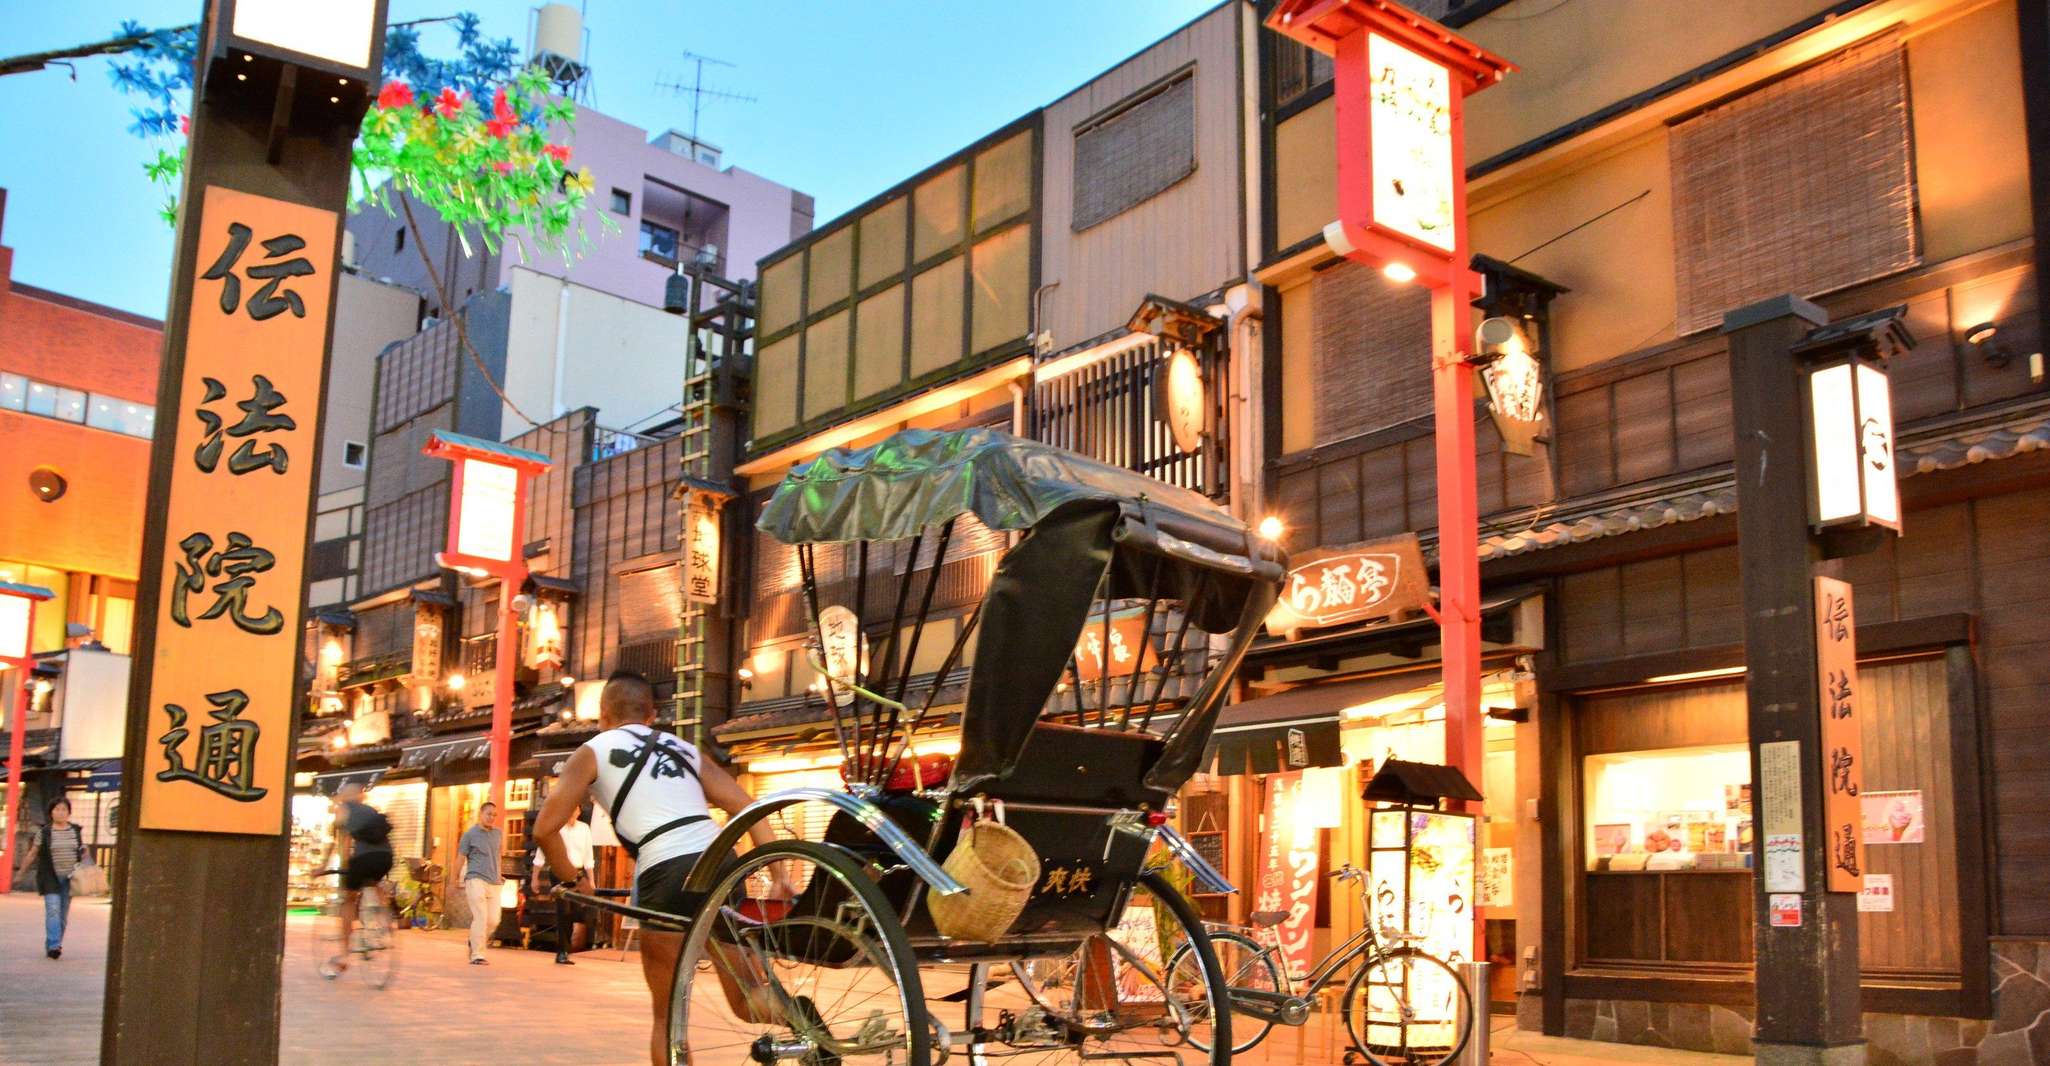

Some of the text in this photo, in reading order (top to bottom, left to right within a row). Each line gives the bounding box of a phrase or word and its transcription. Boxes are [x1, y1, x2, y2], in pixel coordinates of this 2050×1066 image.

[158, 222, 316, 803] 伝法院通
[1823, 593, 1859, 878] 伝法院通
